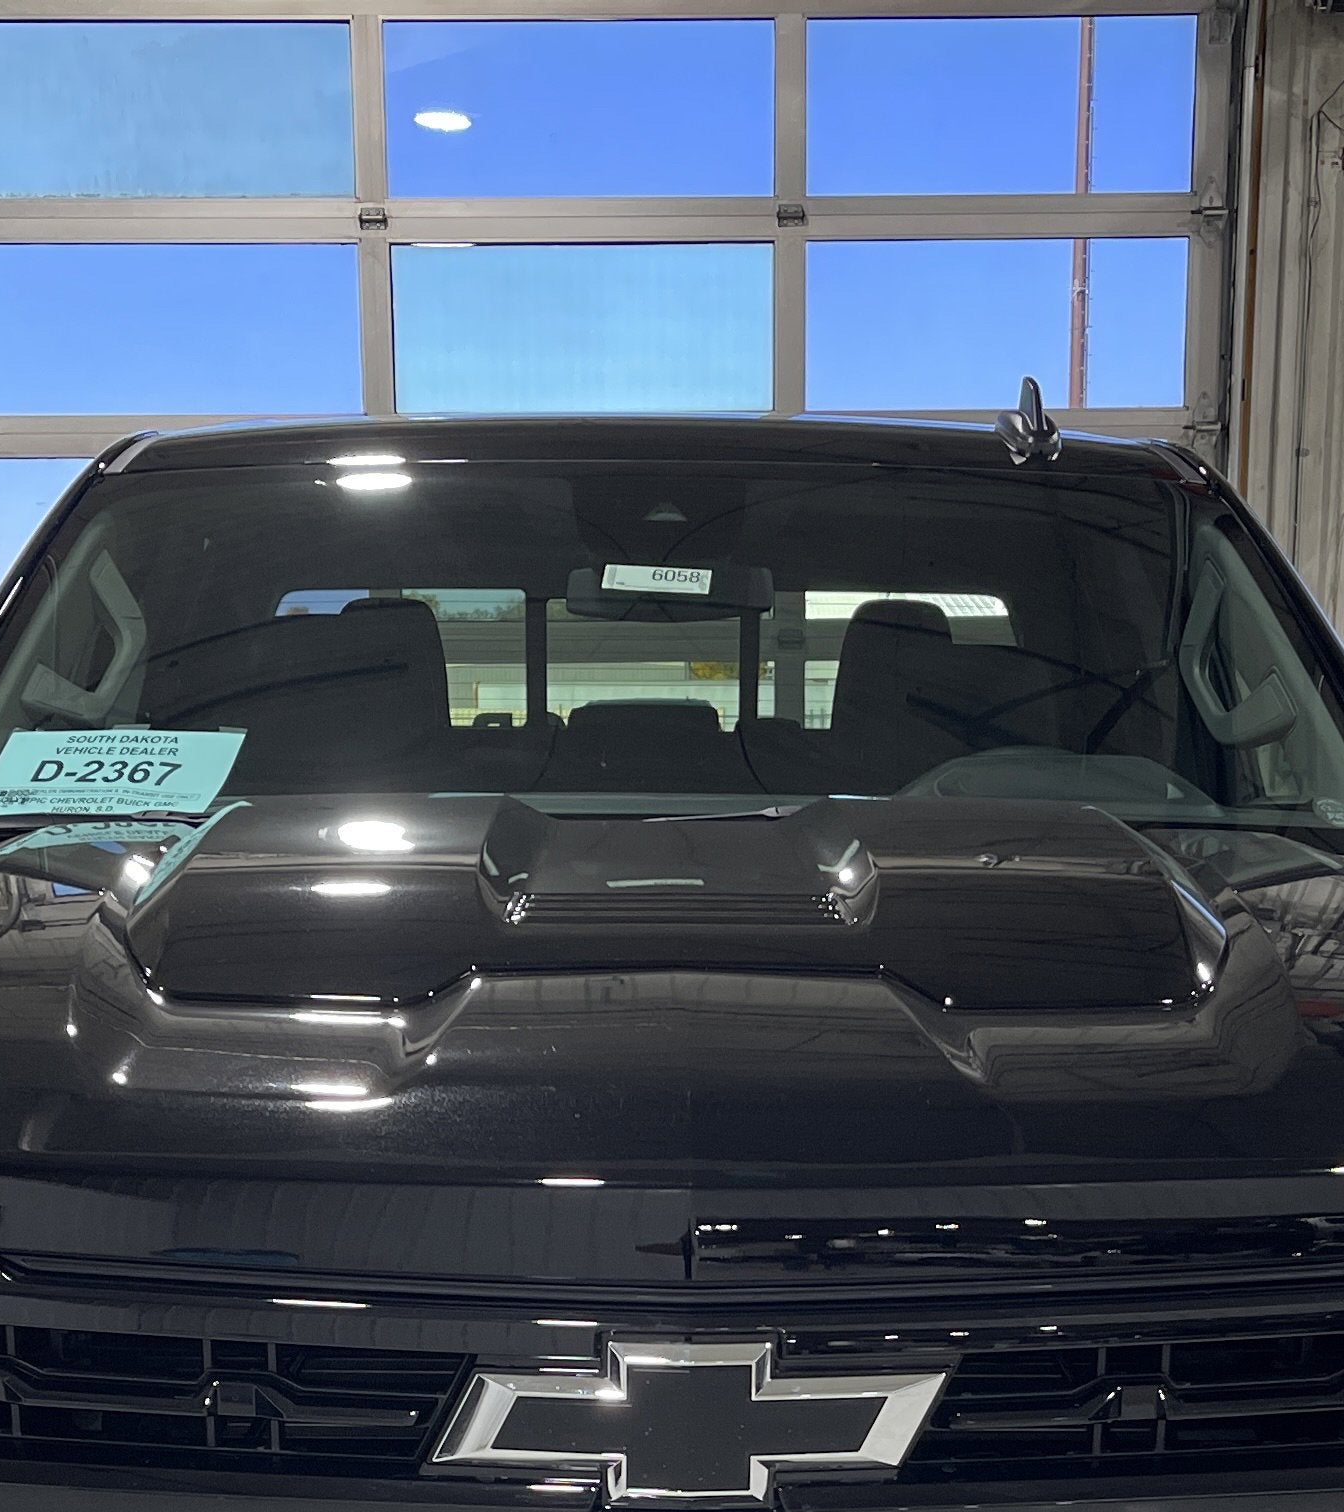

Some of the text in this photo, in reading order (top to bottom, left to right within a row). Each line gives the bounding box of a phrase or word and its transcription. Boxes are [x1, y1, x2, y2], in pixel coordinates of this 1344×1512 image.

[651, 569, 701, 584] 6058
[66, 735, 179, 744] SOUTH DAKOTA
[56, 746, 179, 757] VEHICLE DEALER
[30, 759, 183, 786] D-2367
[50, 796, 115, 804] CHEVROLET
[116, 797, 151, 807] BUICK
